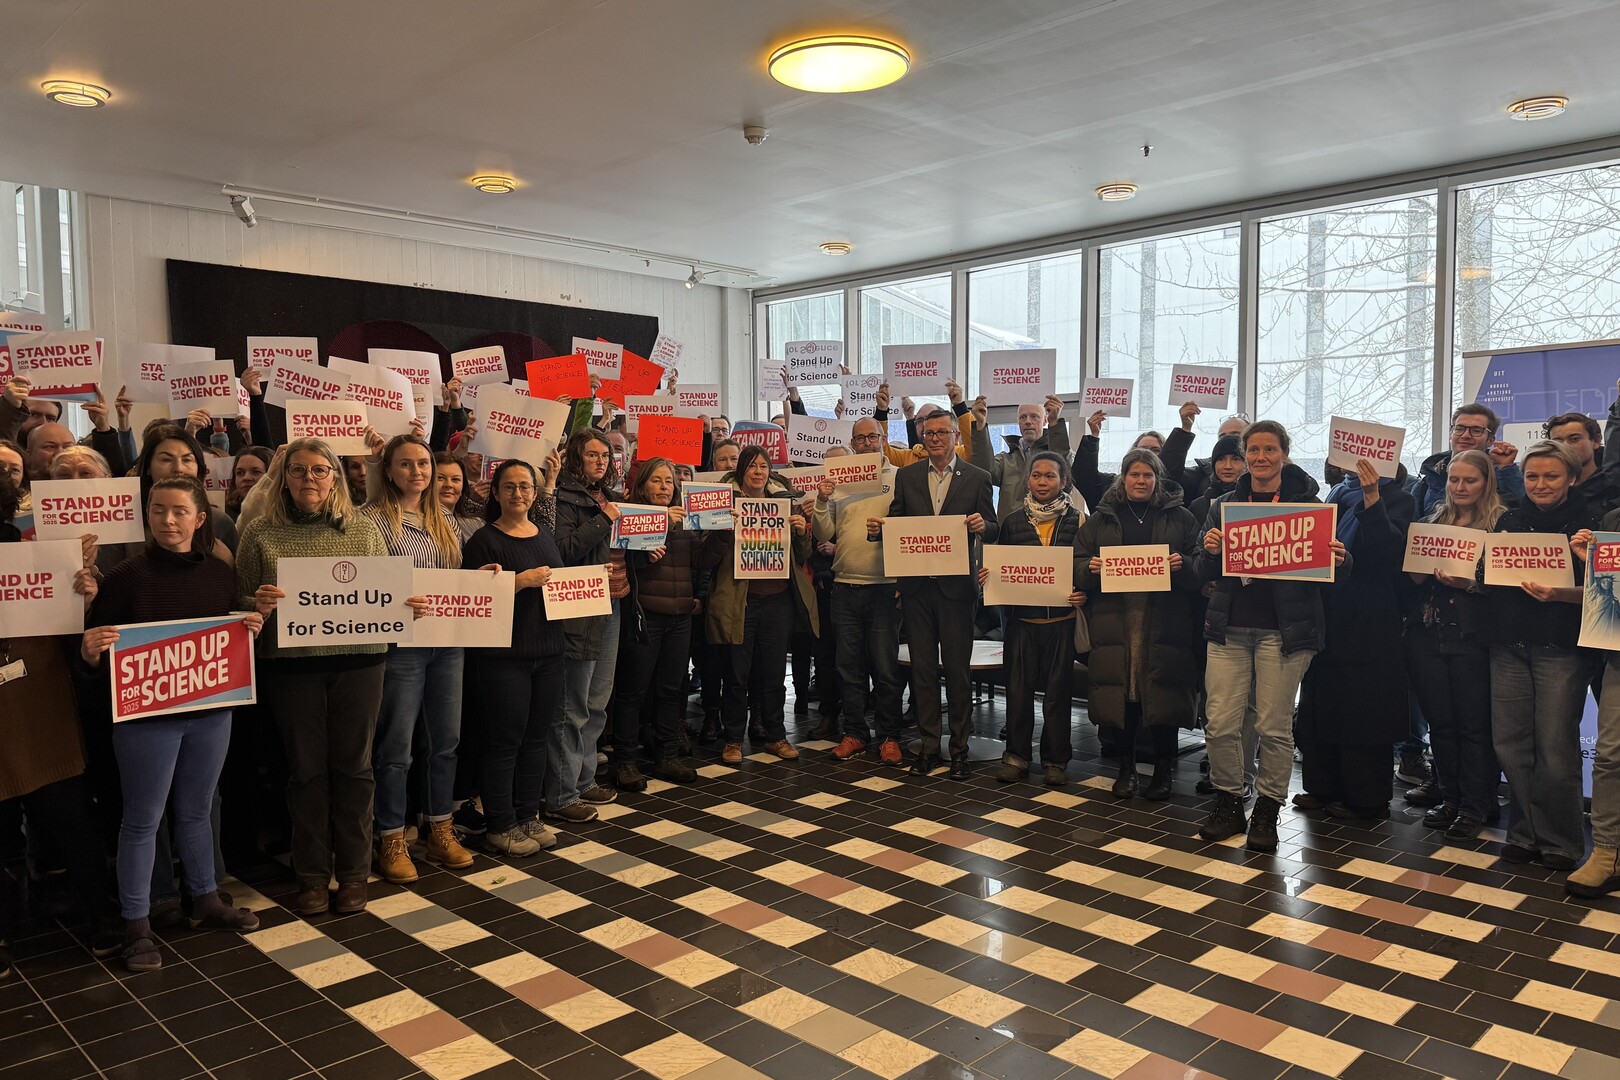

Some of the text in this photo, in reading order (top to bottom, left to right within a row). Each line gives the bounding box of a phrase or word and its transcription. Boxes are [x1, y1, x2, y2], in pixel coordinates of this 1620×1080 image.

[16, 344, 90, 358] STAND UP
[253, 348, 312, 358] STAND UP
[576, 347, 618, 360] STAND UP
[30, 356, 93, 369] SCIENCE
[456, 358, 486, 369] STAND
[587, 357, 618, 368] CIENCE
[791, 356, 832, 366] Stand Up
[895, 361, 923, 369] STAND
[141, 363, 167, 372] STA
[464, 364, 503, 375] SCIENCE
[540, 362, 562, 372] STAND
[994, 368, 1026, 376] STAND
[170, 376, 207, 389] STAND
[209, 374, 228, 385] UP
[277, 368, 341, 394] STAND UP
[800, 372, 838, 380] Science
[1001, 376, 1040, 384] SCIENCE
[1175, 375, 1226, 386] STAND UP
[180, 386, 231, 400] SCIENCE
[347, 383, 385, 397] STAND
[388, 390, 403, 400] UP
[515, 388, 530, 397] STA
[1086, 387, 1113, 396] STAND
[1182, 384, 1225, 396] SCIENCE
[1091, 396, 1127, 405] SCIENCE
[293, 414, 362, 425] STAND UP
[490, 411, 544, 429] STAND UP
[306, 427, 364, 437] SCIENCE
[496, 424, 542, 439] SCIENCE
[657, 424, 679, 433] STAND
[766, 432, 780, 446] UP
[797, 433, 826, 443] Stand
[1334, 430, 1396, 450] STAND UP
[790, 448, 803, 456] for
[1342, 443, 1394, 461] SCIENCE
[829, 466, 861, 476] STAND
[864, 464, 876, 473] UP
[814, 475, 826, 483] UP
[838, 473, 877, 484] SCIENCE
[690, 492, 730, 502] STAND UP
[41, 494, 133, 512] STAND UP
[698, 499, 730, 509] SCIENCE
[742, 502, 778, 516] STAND
[59, 509, 134, 525] SCIENCE
[623, 514, 665, 525] STAND UP
[741, 517, 757, 527] UP
[760, 517, 784, 528] FOR
[630, 523, 665, 532] SCIENCE
[1228, 516, 1315, 550] STAND UP
[900, 535, 950, 545] STAND UP
[1412, 535, 1476, 550] STAND UP
[909, 544, 952, 554] SCIENCE
[1421, 547, 1475, 562] SCIENCE
[1492, 547, 1564, 557] STAND UP
[1229, 541, 1313, 569] FOR SCIENCE
[741, 551, 784, 571] SCIENCES
[1106, 556, 1164, 567] STAND UP
[1504, 558, 1566, 569] SCIENCE
[1001, 565, 1054, 575] STAND UP
[1116, 566, 1164, 576] SCIENCE
[1230, 564, 1242, 572] 2025
[26, 572, 52, 585] UP
[1010, 575, 1055, 584] SCIENCE
[546, 578, 603, 592] STAND UP
[298, 590, 393, 607] Stand Up
[425, 594, 492, 606] STAND UP
[558, 589, 605, 602] SCIENCE
[436, 607, 492, 618] SCIENCE
[287, 620, 404, 636] for Science
[121, 630, 229, 684] STAND UP
[121, 658, 229, 706] FOR SCIENCE
[123, 702, 139, 714] 2025
